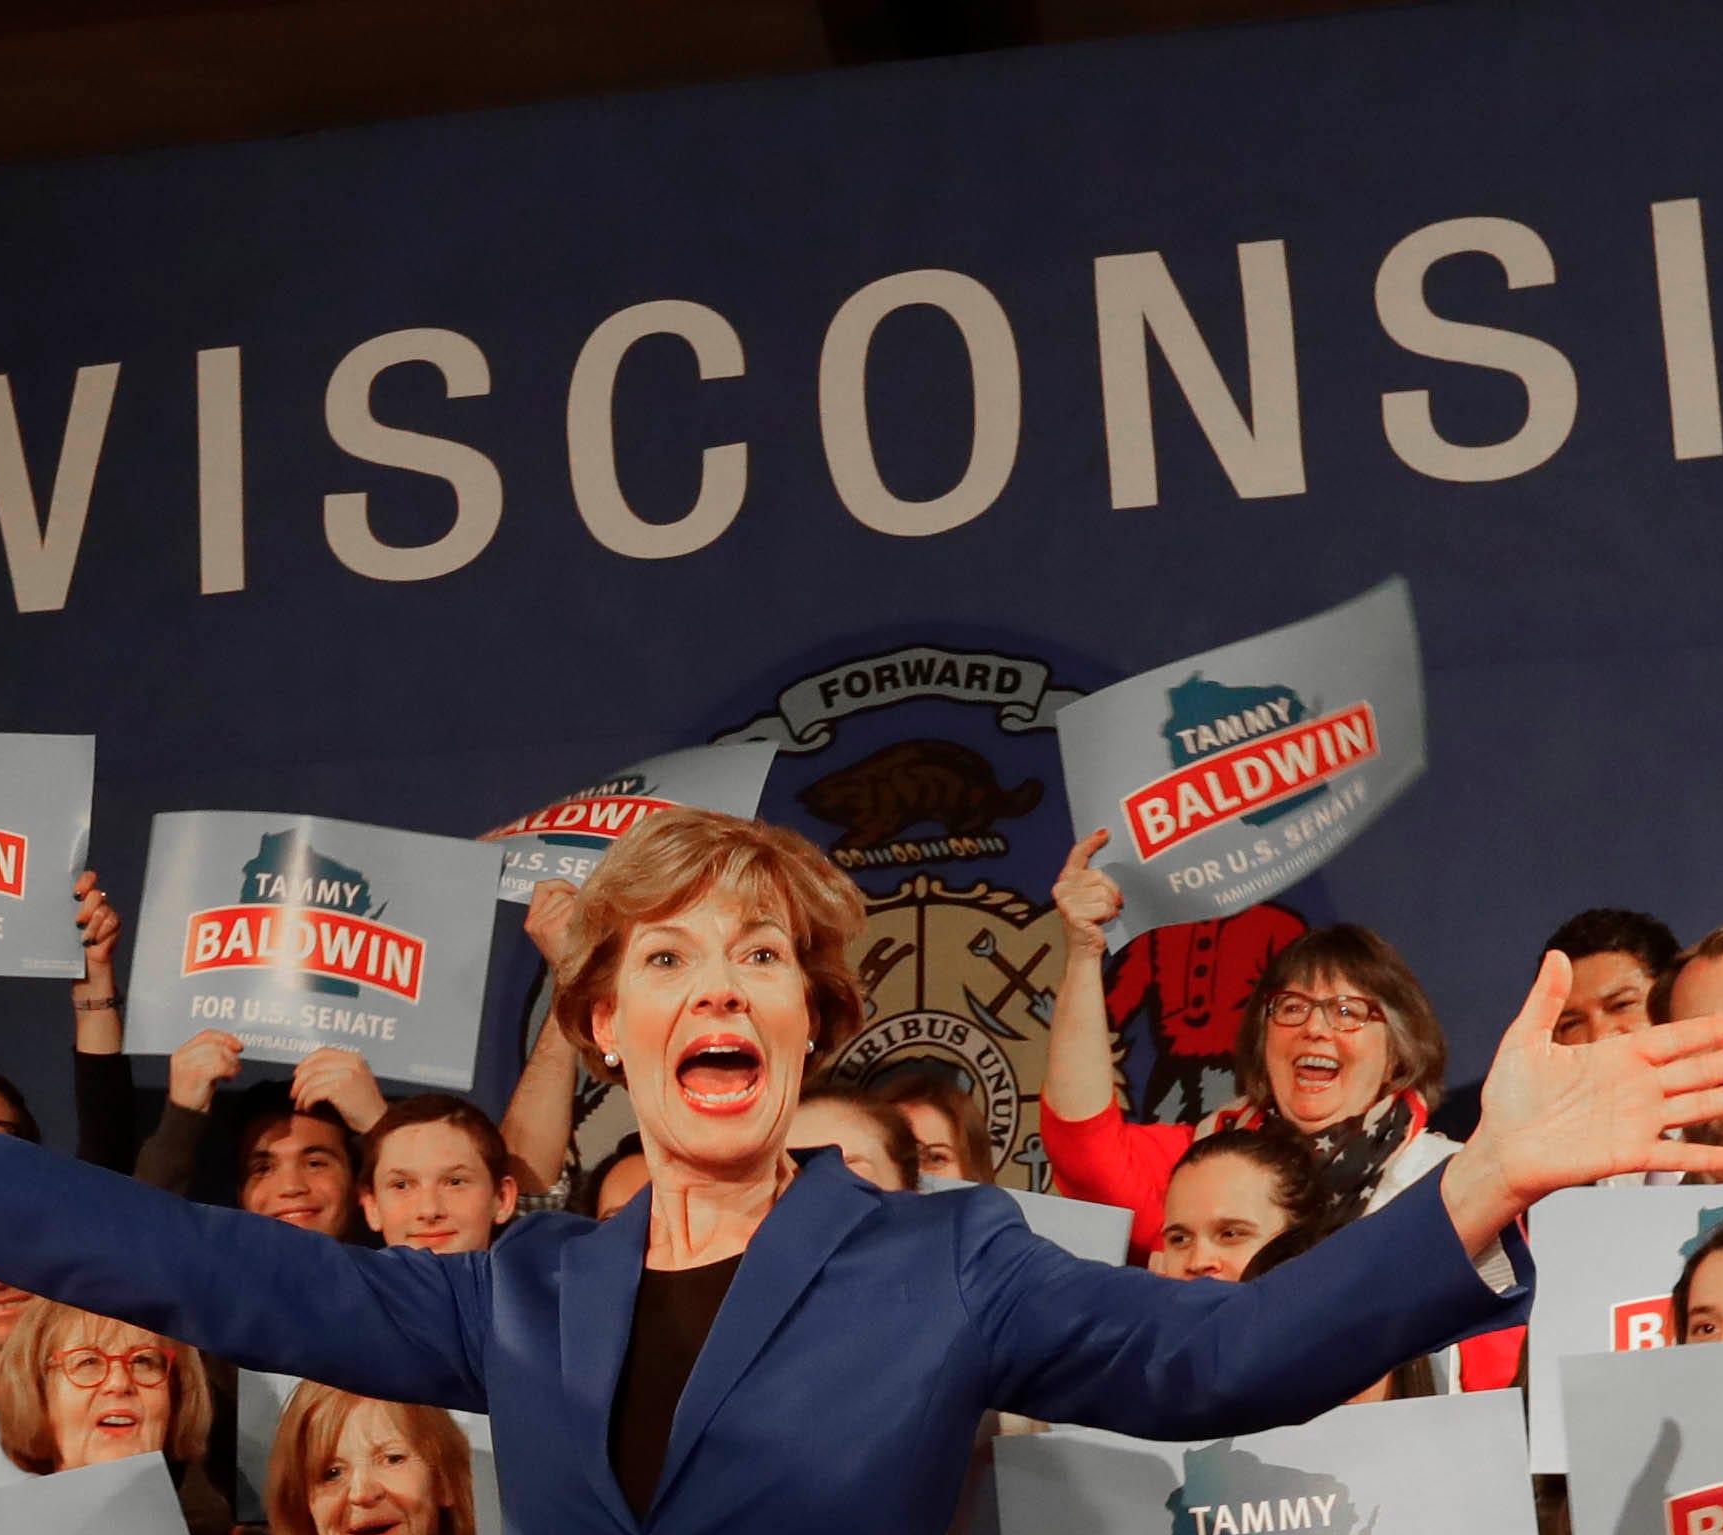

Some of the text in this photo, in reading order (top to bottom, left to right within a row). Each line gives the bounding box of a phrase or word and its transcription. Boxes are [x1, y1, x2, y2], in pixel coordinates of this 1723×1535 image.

[818, 657, 1022, 708] FORWARD
[1176, 698, 1293, 754] TAMMY
[1138, 715, 1371, 846] BALDWIN
[254, 872, 361, 907] TAMMY
[1168, 860, 1225, 894] FOR
[1227, 839, 1282, 874] U.S.
[194, 921, 414, 988] BALDWIN
[191, 996, 235, 1019] FOR
[300, 1005, 398, 1040] SENATE
[837, 1018, 971, 1080] URIBUS
